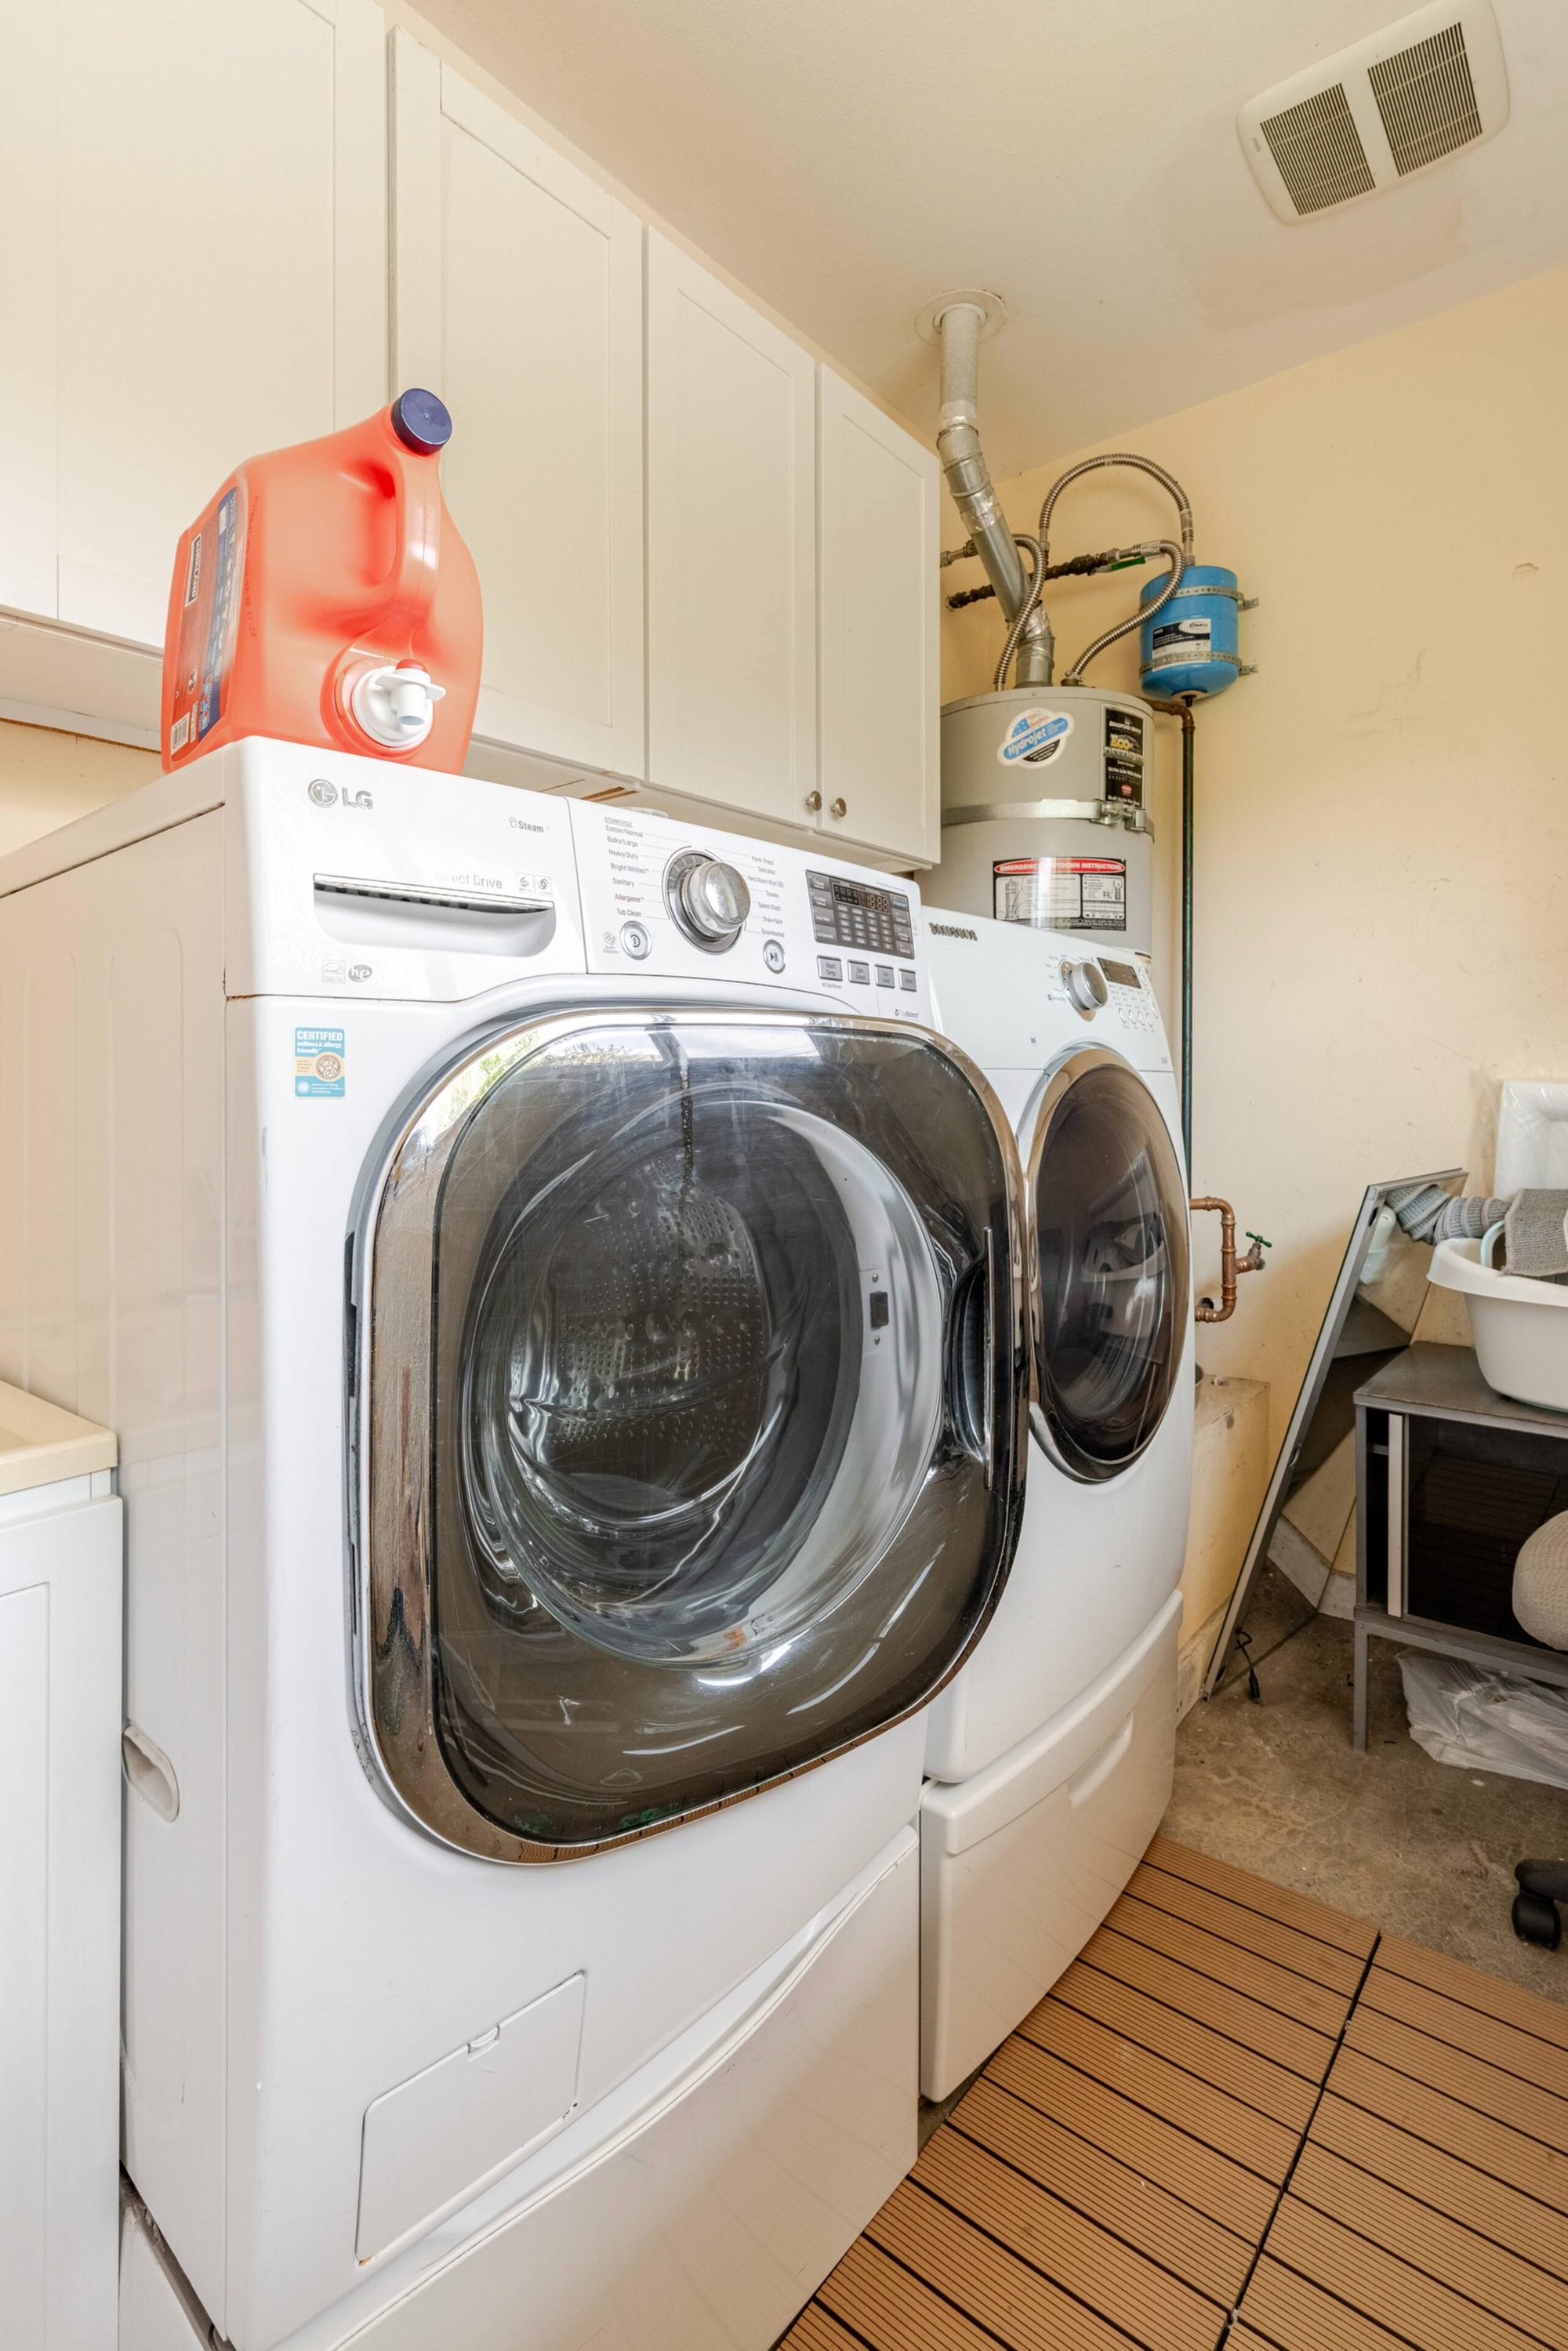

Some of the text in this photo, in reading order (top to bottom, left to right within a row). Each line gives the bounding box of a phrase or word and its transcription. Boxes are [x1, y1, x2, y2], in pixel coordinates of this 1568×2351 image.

[191, 539, 201, 599] KIRKLAND
[1007, 726, 1049, 757] Hydrojet
[341, 787, 374, 810] LG
[518, 820, 545, 833] Steam
[605, 825, 644, 838] Cotton/Normal
[607, 836, 639, 847] Bulky/Large
[608, 848, 639, 861] Heavy Duty
[610, 862, 627, 872] Bright
[1000, 862, 1040, 872] EMERGENC
[1080, 862, 1123, 871] INSTRUCTIONS
[473, 874, 503, 890] Drive
[612, 877, 635, 887] Sanitary
[626, 909, 642, 918] Clean
[928, 921, 978, 942] SAMSUNG
[350, 965, 370, 980] he
[296, 1030, 343, 1041] CERTIFIED
